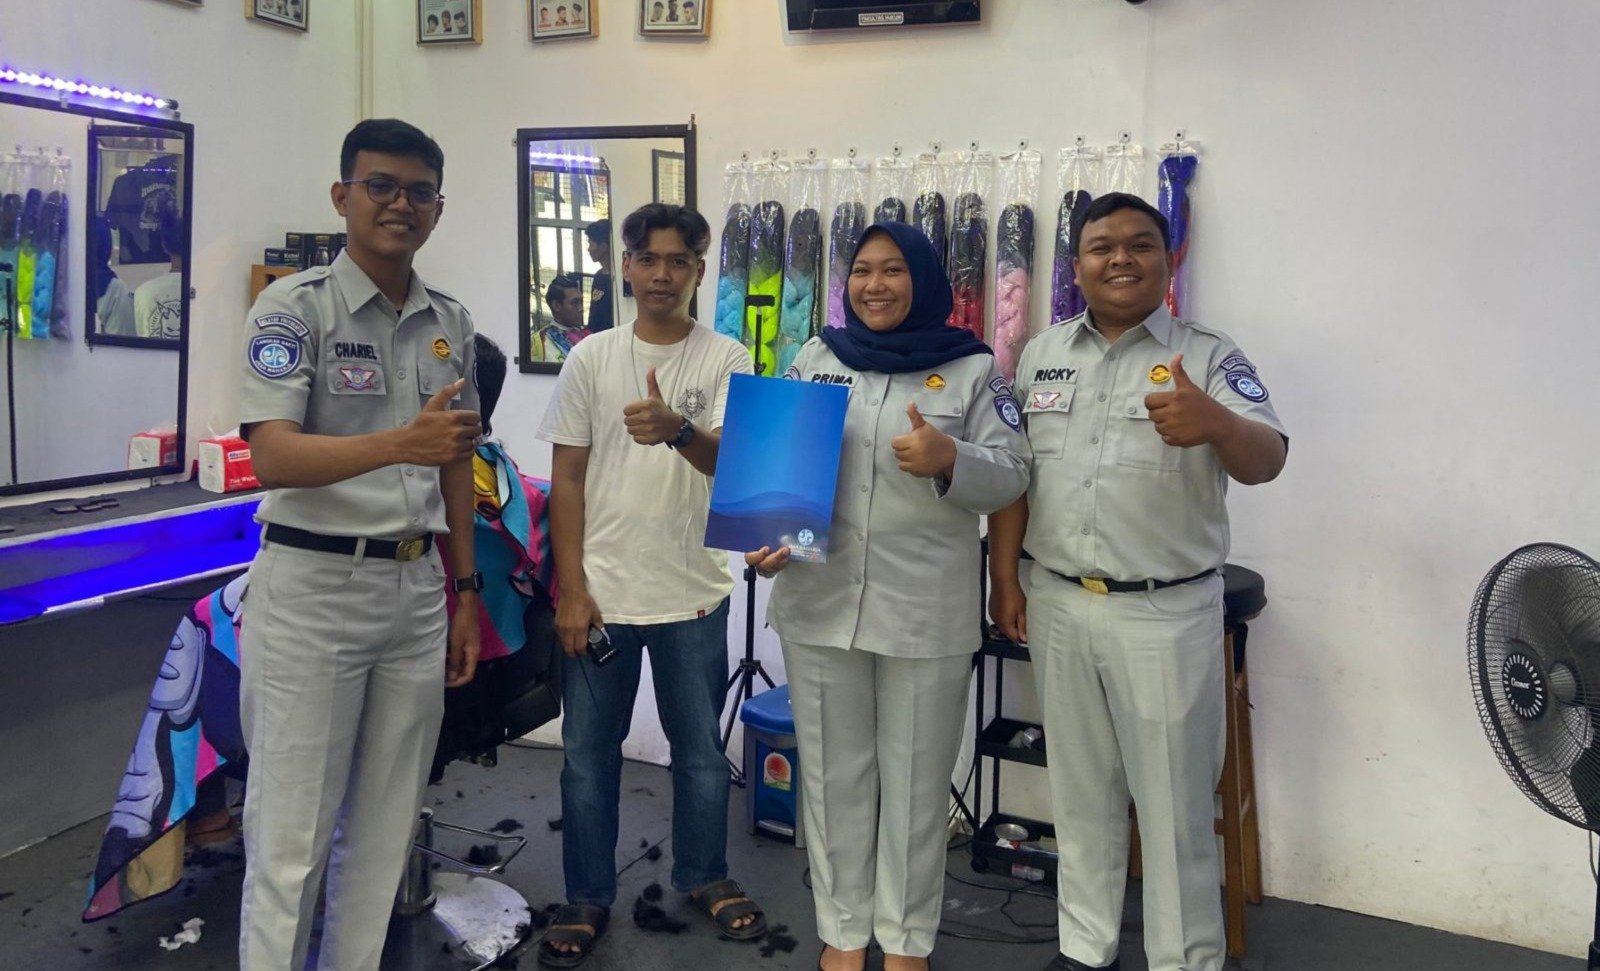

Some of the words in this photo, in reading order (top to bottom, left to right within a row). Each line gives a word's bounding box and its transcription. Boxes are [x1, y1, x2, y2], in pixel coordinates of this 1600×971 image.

[335, 342, 378, 360] CHARIEL
[811, 373, 853, 385] PRIMA
[1034, 368, 1076, 382] RICKY
